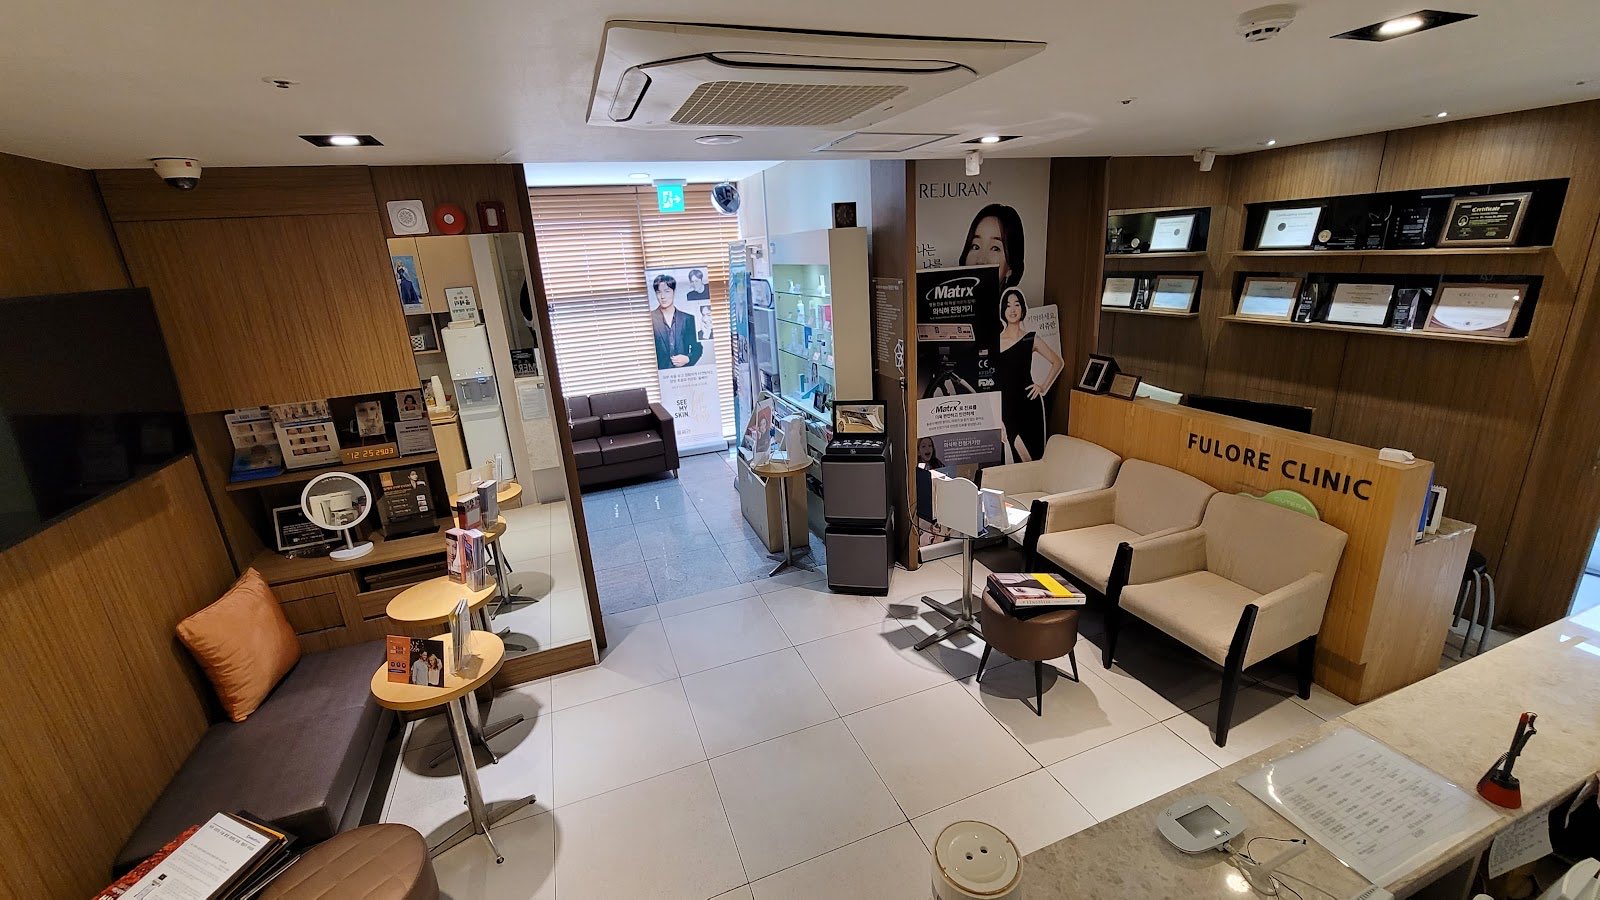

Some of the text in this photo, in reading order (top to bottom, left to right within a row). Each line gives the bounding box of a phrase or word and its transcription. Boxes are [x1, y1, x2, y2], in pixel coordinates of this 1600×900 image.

[919, 182, 989, 199] REJURAN
[934, 285, 974, 300] Matrx
[674, 411, 689, 419] SKIN
[935, 405, 958, 414] Matrx
[1188, 433, 1373, 501] FULORE CLINIC
